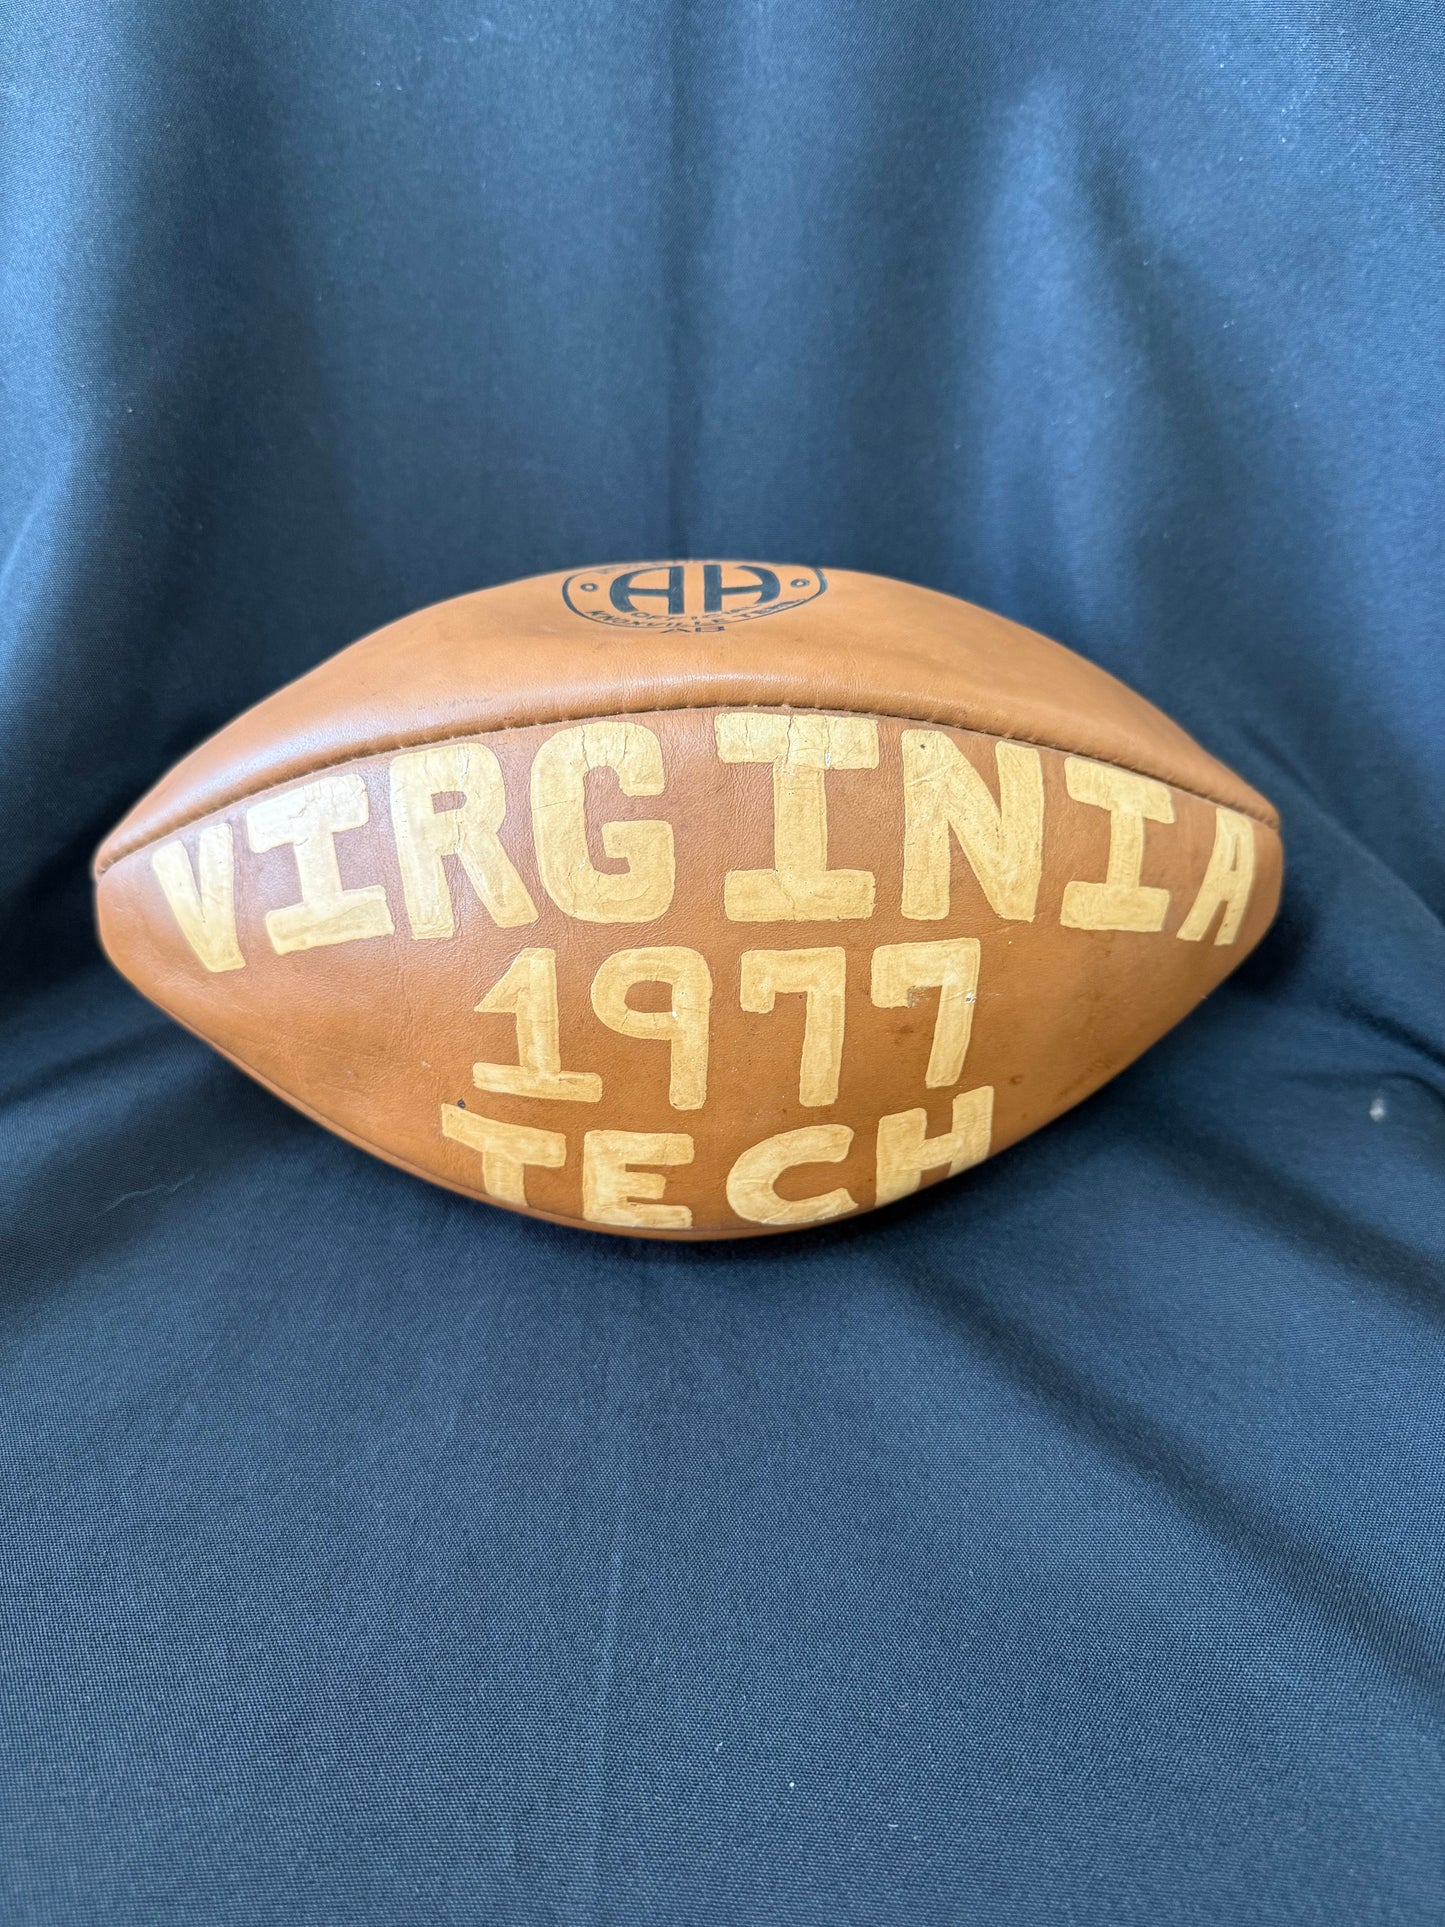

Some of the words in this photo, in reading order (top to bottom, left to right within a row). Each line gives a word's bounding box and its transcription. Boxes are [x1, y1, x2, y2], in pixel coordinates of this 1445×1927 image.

[149, 713, 1256, 973] VIRGINIA
[474, 938, 981, 1110] 1977
[441, 1086, 993, 1228] TECH
